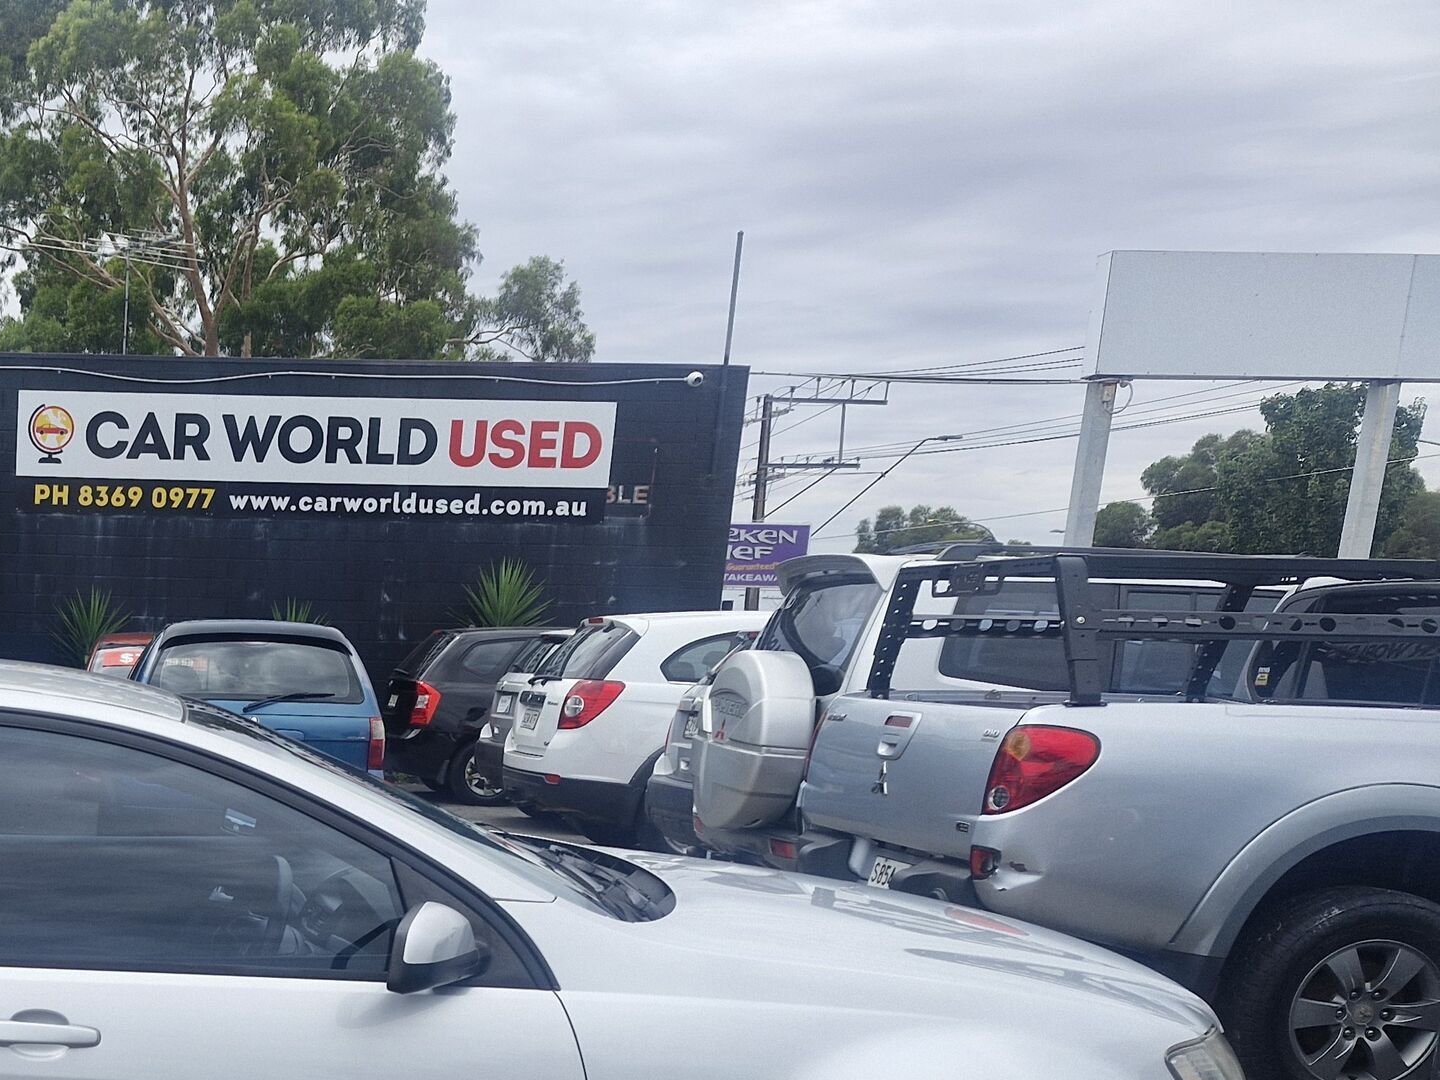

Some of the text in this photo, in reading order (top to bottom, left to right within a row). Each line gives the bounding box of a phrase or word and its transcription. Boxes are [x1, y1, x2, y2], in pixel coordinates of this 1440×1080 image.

[85, 410, 602, 469] CAR WORLD USED
[34, 485, 588, 517] PH 8369 0977 www.carworldused.com.au
